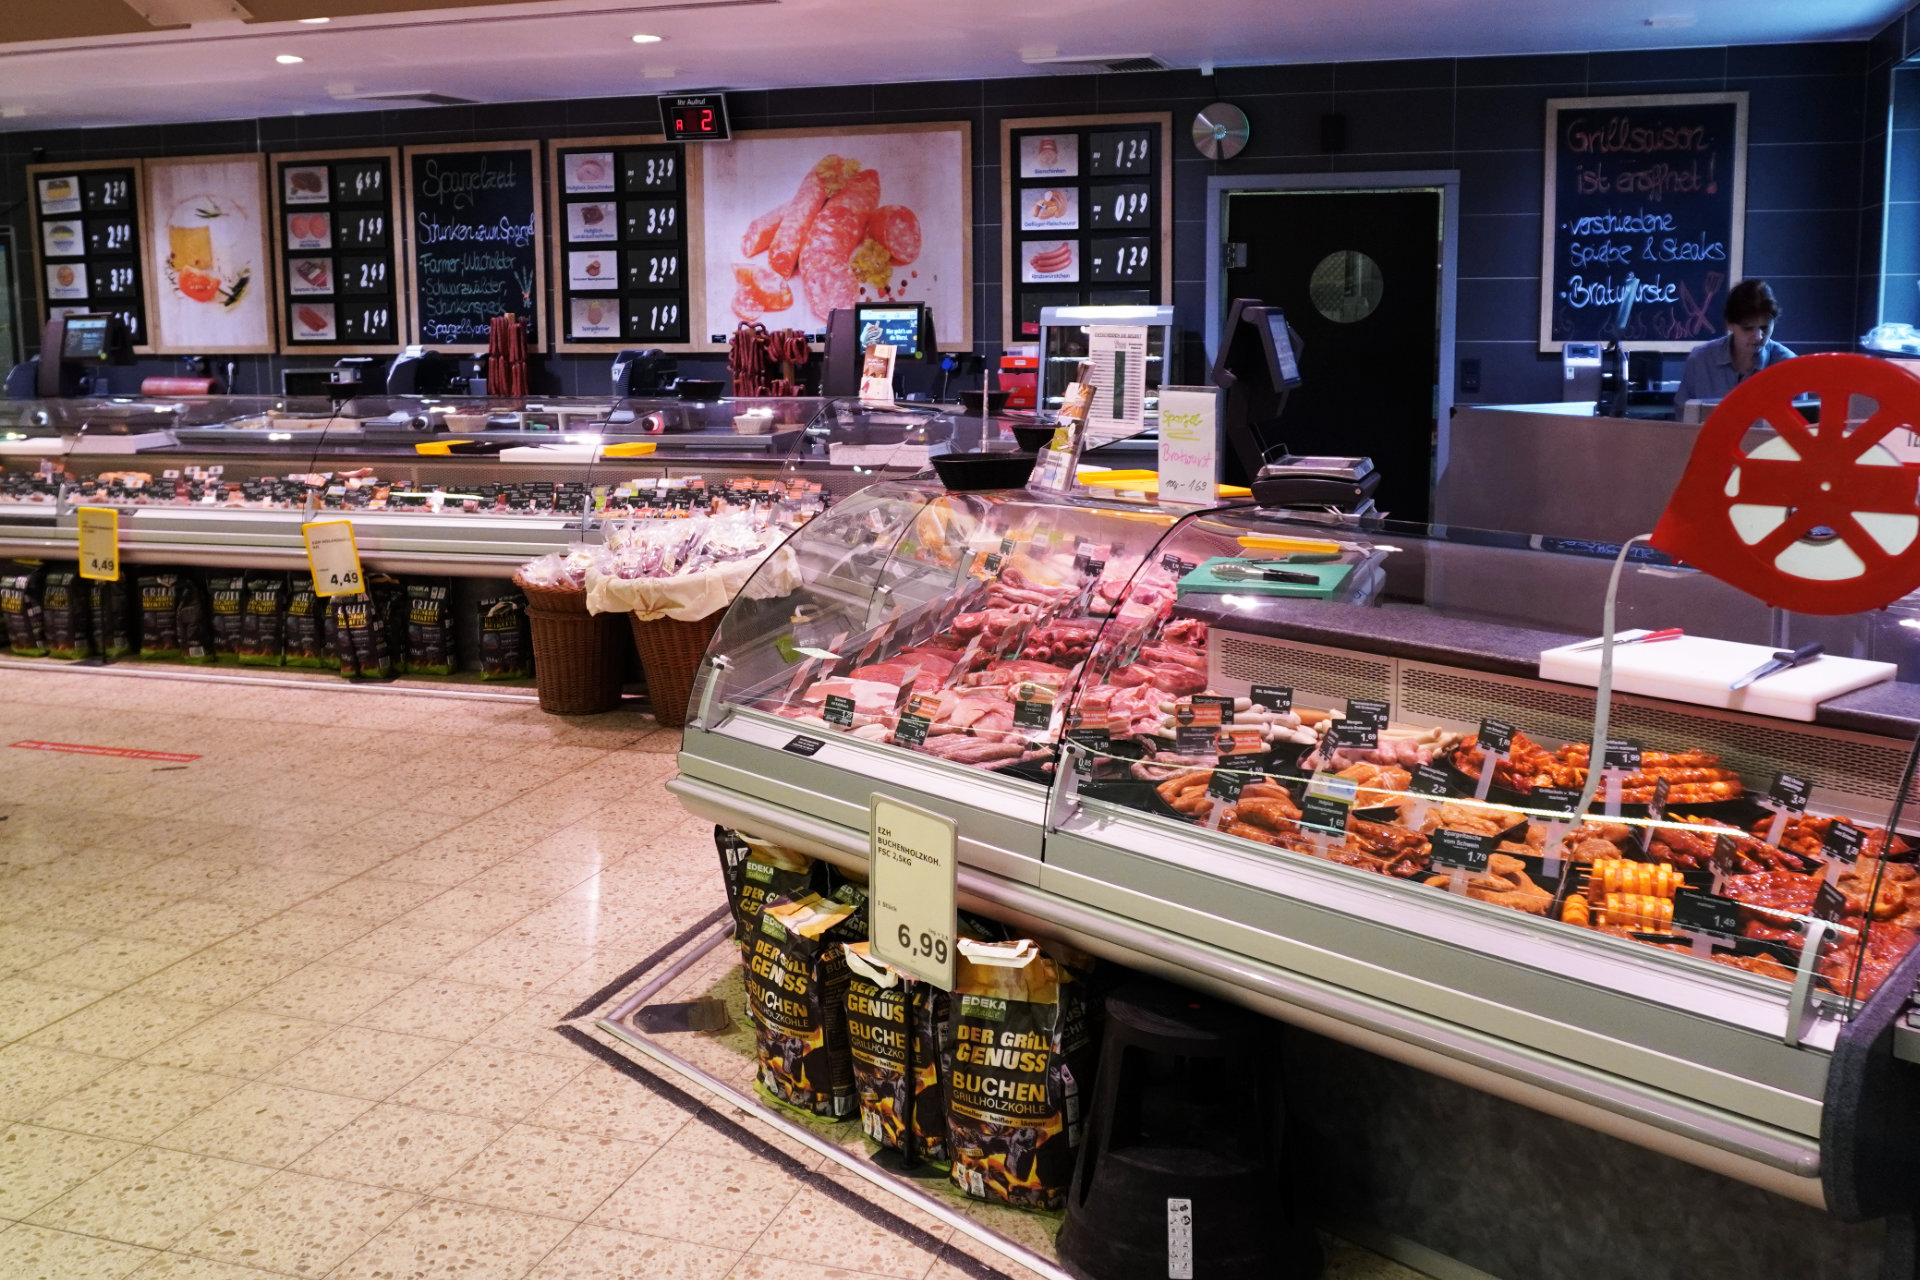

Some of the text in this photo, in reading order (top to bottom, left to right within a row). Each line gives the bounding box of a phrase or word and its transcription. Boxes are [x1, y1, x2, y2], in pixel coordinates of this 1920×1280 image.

[677, 98, 706, 106] Ihr Aufruf
[675, 109, 713, 132] A 2
[1567, 116, 1710, 153] Grillsaison
[422, 155, 517, 210] Spargelzeit
[1569, 207, 1678, 236] verschiedene
[1642, 236, 1658, 261] &
[1658, 231, 1727, 262] Steaks
[91, 559, 114, 571] 4,49
[330, 572, 359, 587] 4,49
[1360, 733, 1377, 742] 1.69
[877, 826, 892, 837] EZH
[877, 837, 941, 867] BUCHENHOLZKOH.
[877, 847, 912, 866] FSC 2,5KG
[1467, 851, 1487, 862] 1.79
[746, 862, 774, 875] EDEKA
[742, 885, 765, 902] DER
[1713, 914, 1736, 928] 1.49
[755, 939, 781, 962] DER
[897, 924, 948, 964] 6,99
[751, 979, 808, 1018] BUCHEN
[849, 980, 879, 997] DER
[847, 993, 918, 1024] GENUS
[962, 995, 1007, 1011] EDEKA
[957, 1024, 995, 1045] DER
[956, 1042, 1048, 1073] GENUSS
[952, 1070, 1045, 1103] BUCHEN
[953, 1089, 1046, 1114] GRILLHOLZKOHLE
